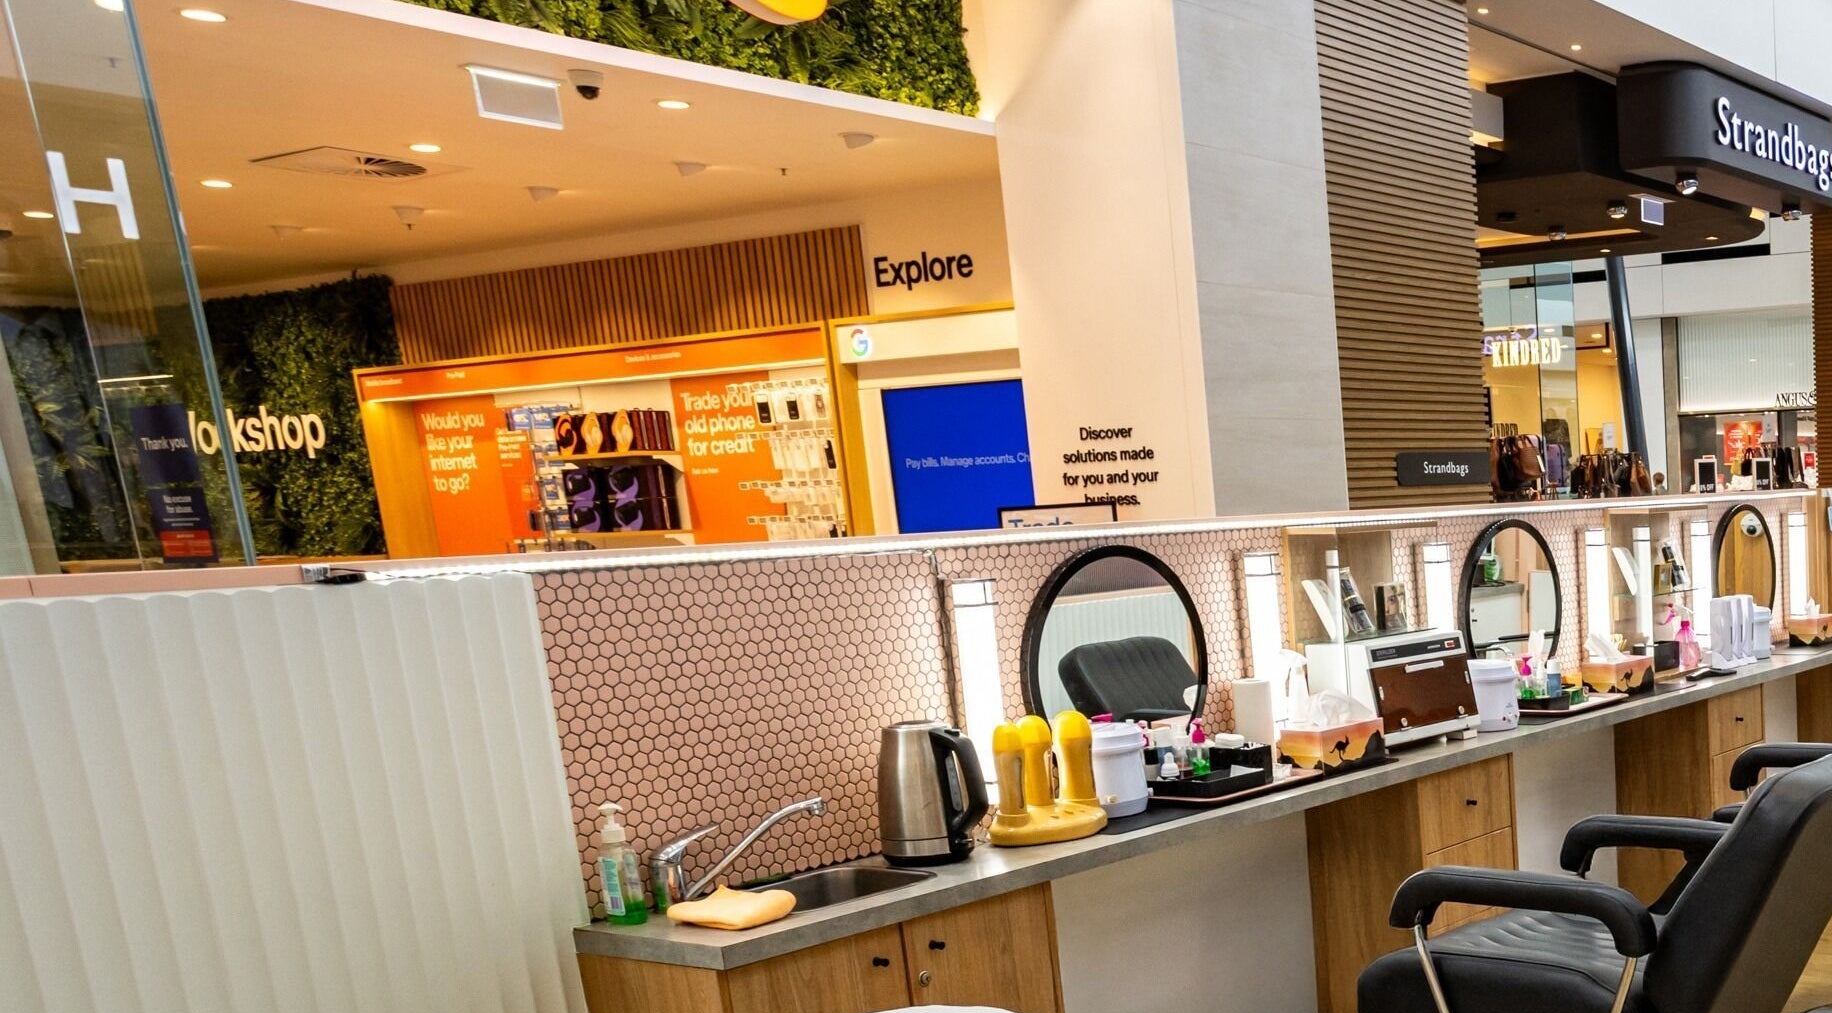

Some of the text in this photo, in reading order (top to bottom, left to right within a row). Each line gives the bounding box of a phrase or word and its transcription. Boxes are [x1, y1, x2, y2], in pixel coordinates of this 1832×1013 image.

[874, 251, 974, 291] Explore
[1491, 337, 1561, 368] KINDRED
[680, 390, 754, 413] Trade your
[187, 405, 326, 459] okshop
[421, 412, 485, 432] Would you
[684, 412, 756, 437] old phone
[1079, 426, 1133, 441] Discover
[141, 436, 188, 452] Thank you.
[425, 434, 447, 452] like
[448, 435, 474, 454] your
[687, 436, 756, 457] for credit
[429, 453, 478, 471] internet
[905, 458, 921, 470] Pay
[921, 457, 939, 468] bills.
[940, 456, 974, 468] Manage
[974, 453, 1016, 465] accounts.
[1063, 446, 1154, 464] solutions made
[1423, 461, 1470, 475] Strandbags
[433, 473, 470, 495] to go?
[1062, 469, 1159, 488] for you and your
[1084, 492, 1141, 507] business.
